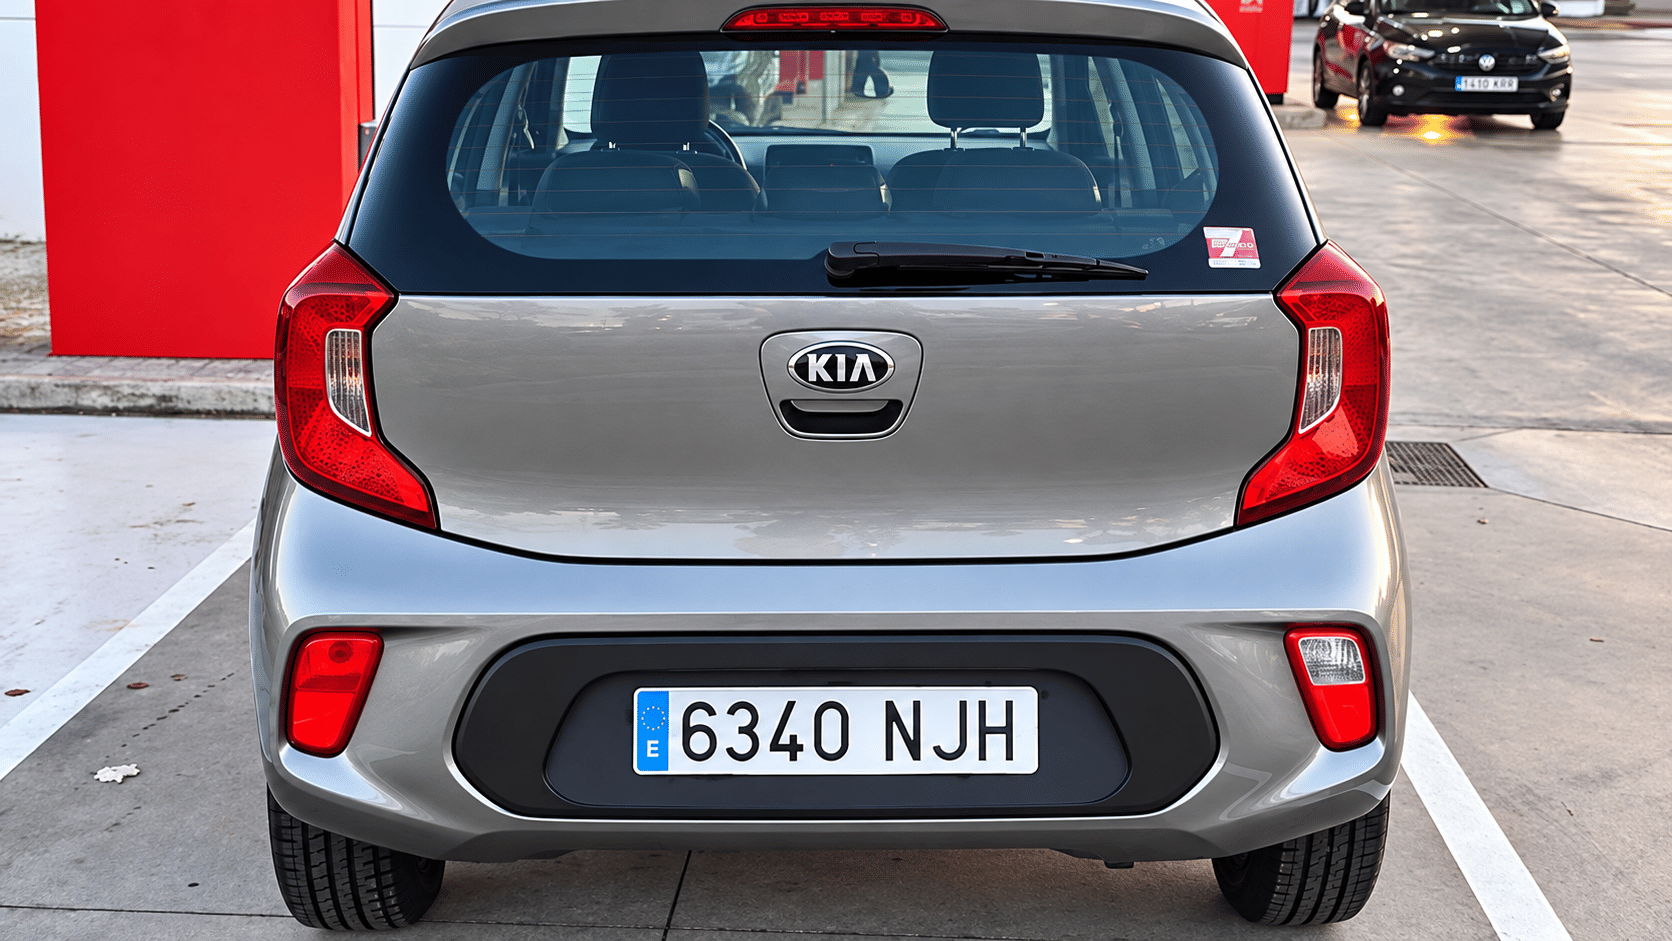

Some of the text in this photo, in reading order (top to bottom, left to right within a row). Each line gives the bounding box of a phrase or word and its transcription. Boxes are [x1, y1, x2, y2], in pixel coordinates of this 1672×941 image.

[1463, 79, 1489, 88] 1410
[806, 353, 877, 382] KIA
[681, 700, 1014, 762] 6340 NJH
[646, 740, 660, 758] E
